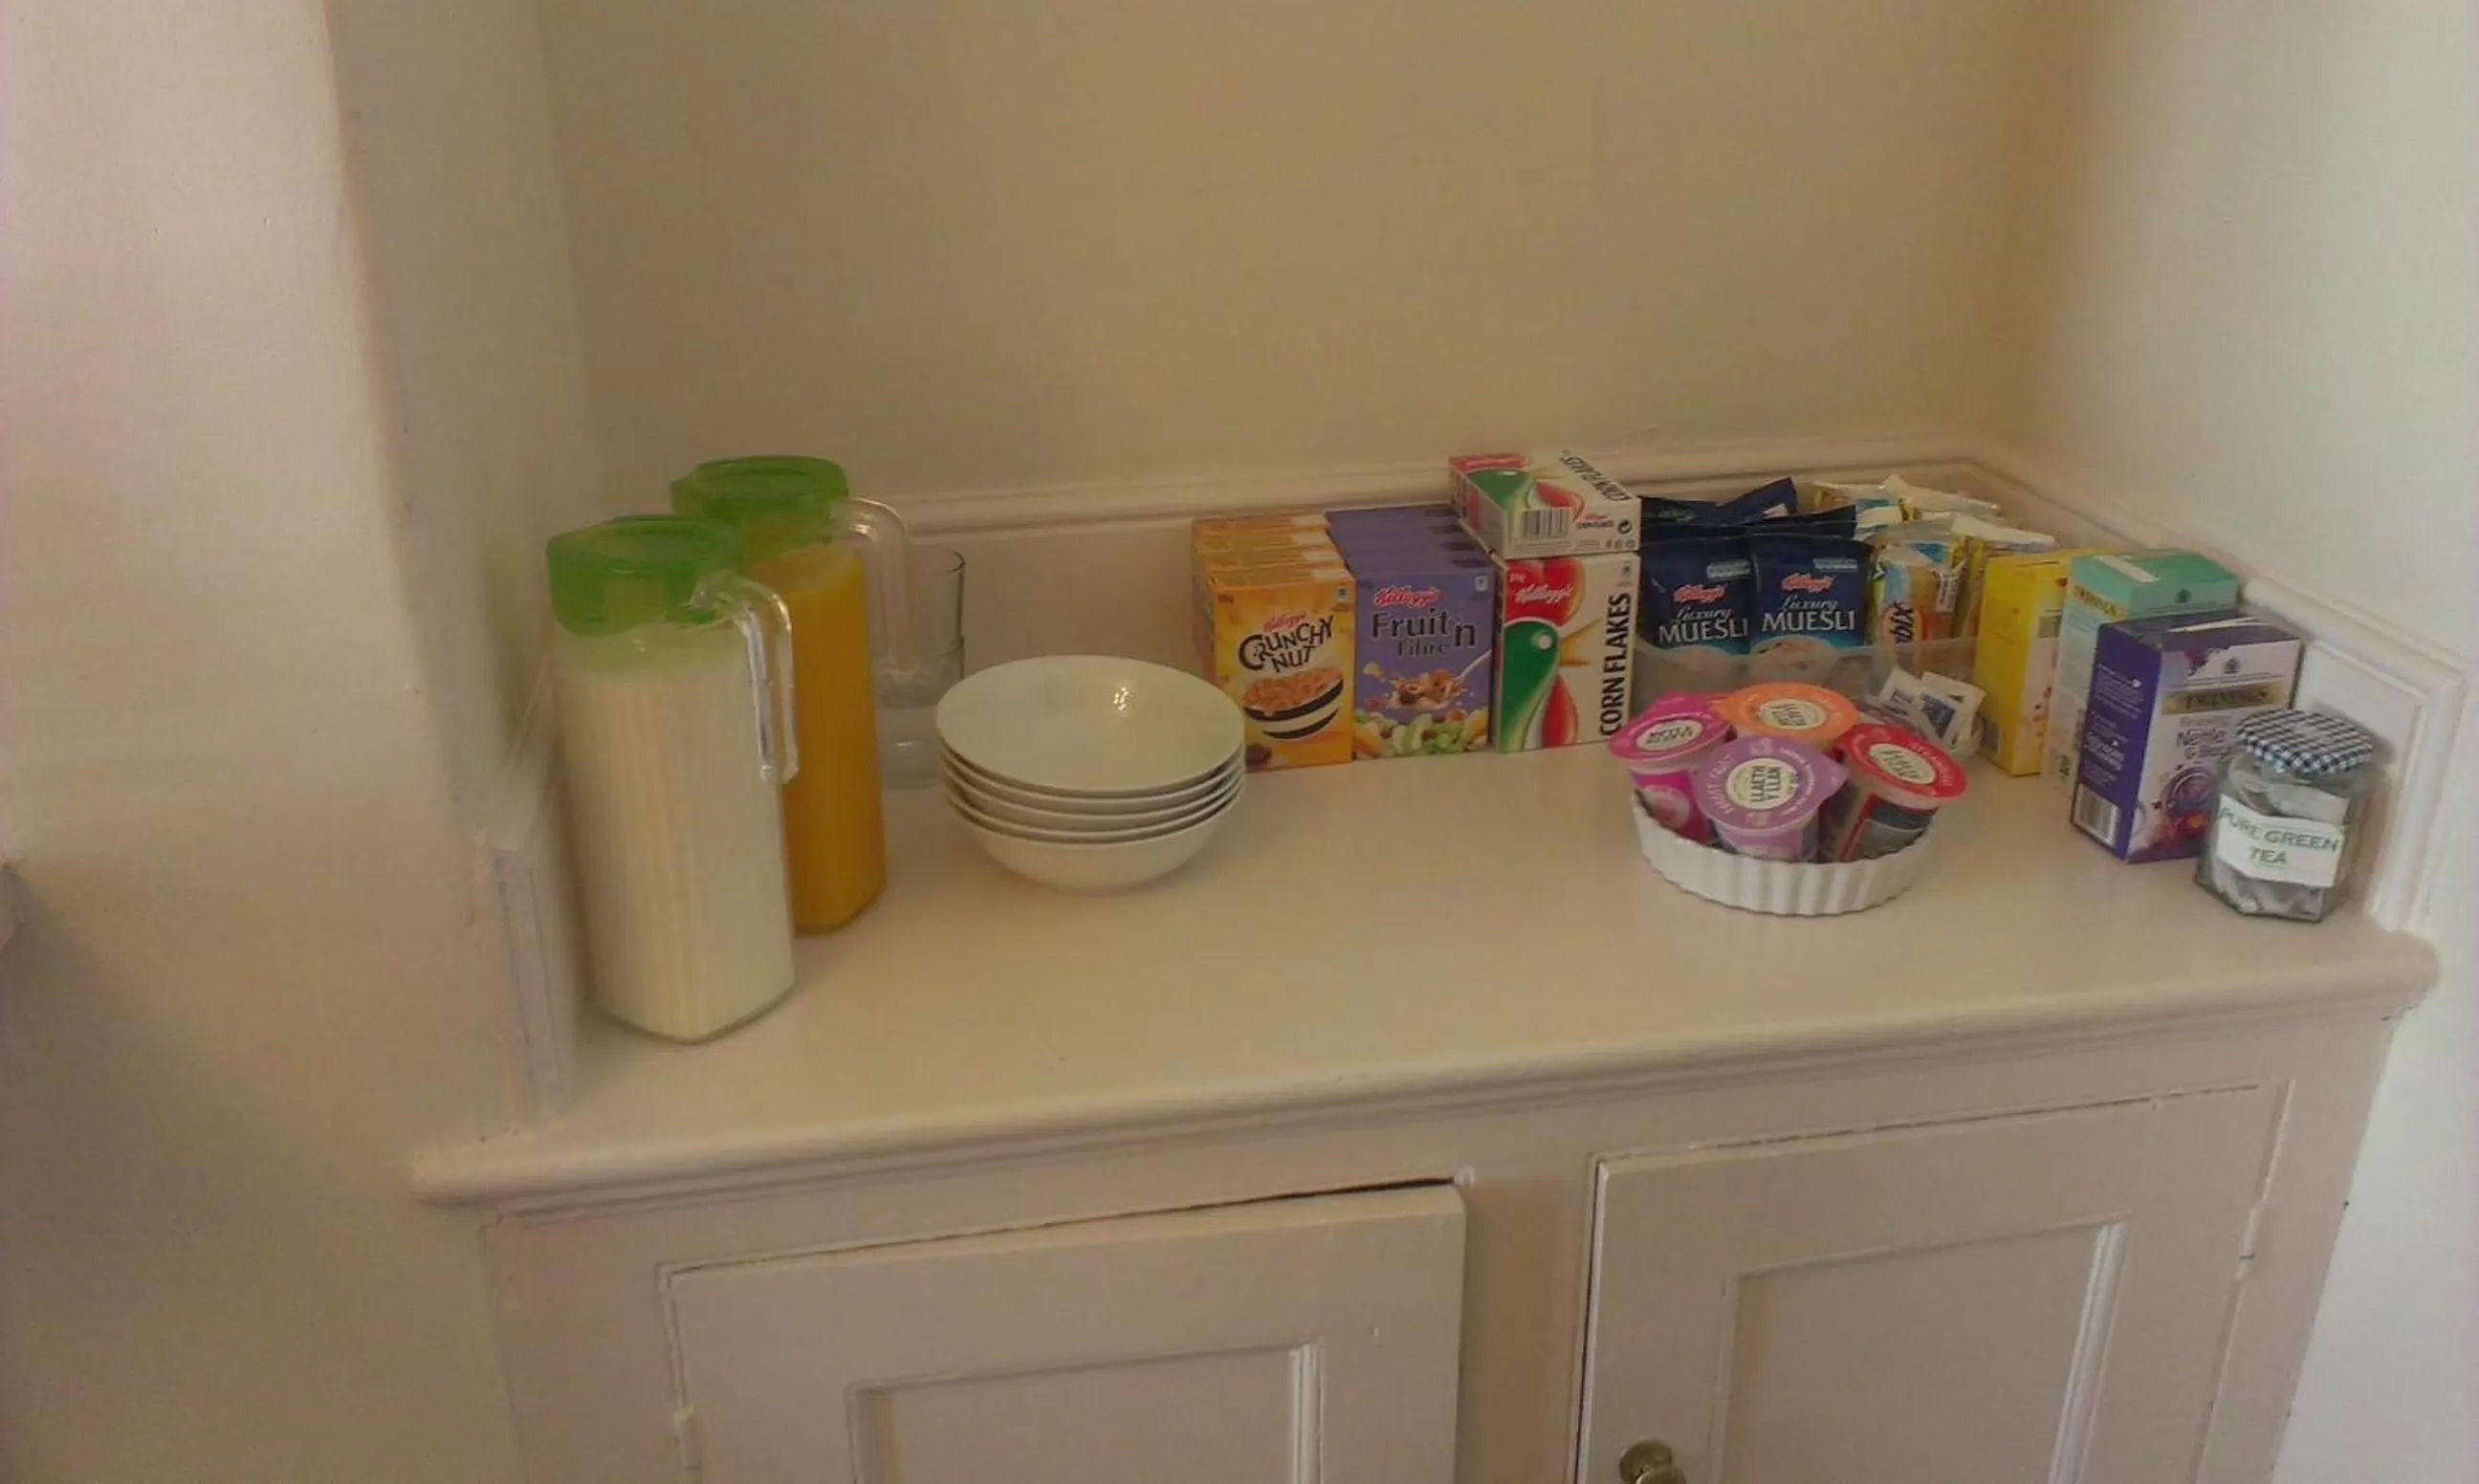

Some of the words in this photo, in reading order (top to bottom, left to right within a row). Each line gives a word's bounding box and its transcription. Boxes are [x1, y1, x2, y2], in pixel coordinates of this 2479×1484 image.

[1372, 608, 1450, 638] Fruit
[1604, 593, 1632, 673] FLAKES
[1658, 618, 1749, 644] MUESLI
[1762, 610, 1856, 632] MUESLI
[1239, 615, 1334, 670] CRUNCHY
[1272, 645, 1317, 673] NUT
[1599, 675, 1626, 735] CORN
[2218, 806, 2263, 840] PURE
[2264, 830, 2340, 854] GREEN
[2249, 846, 2288, 865] TEA
